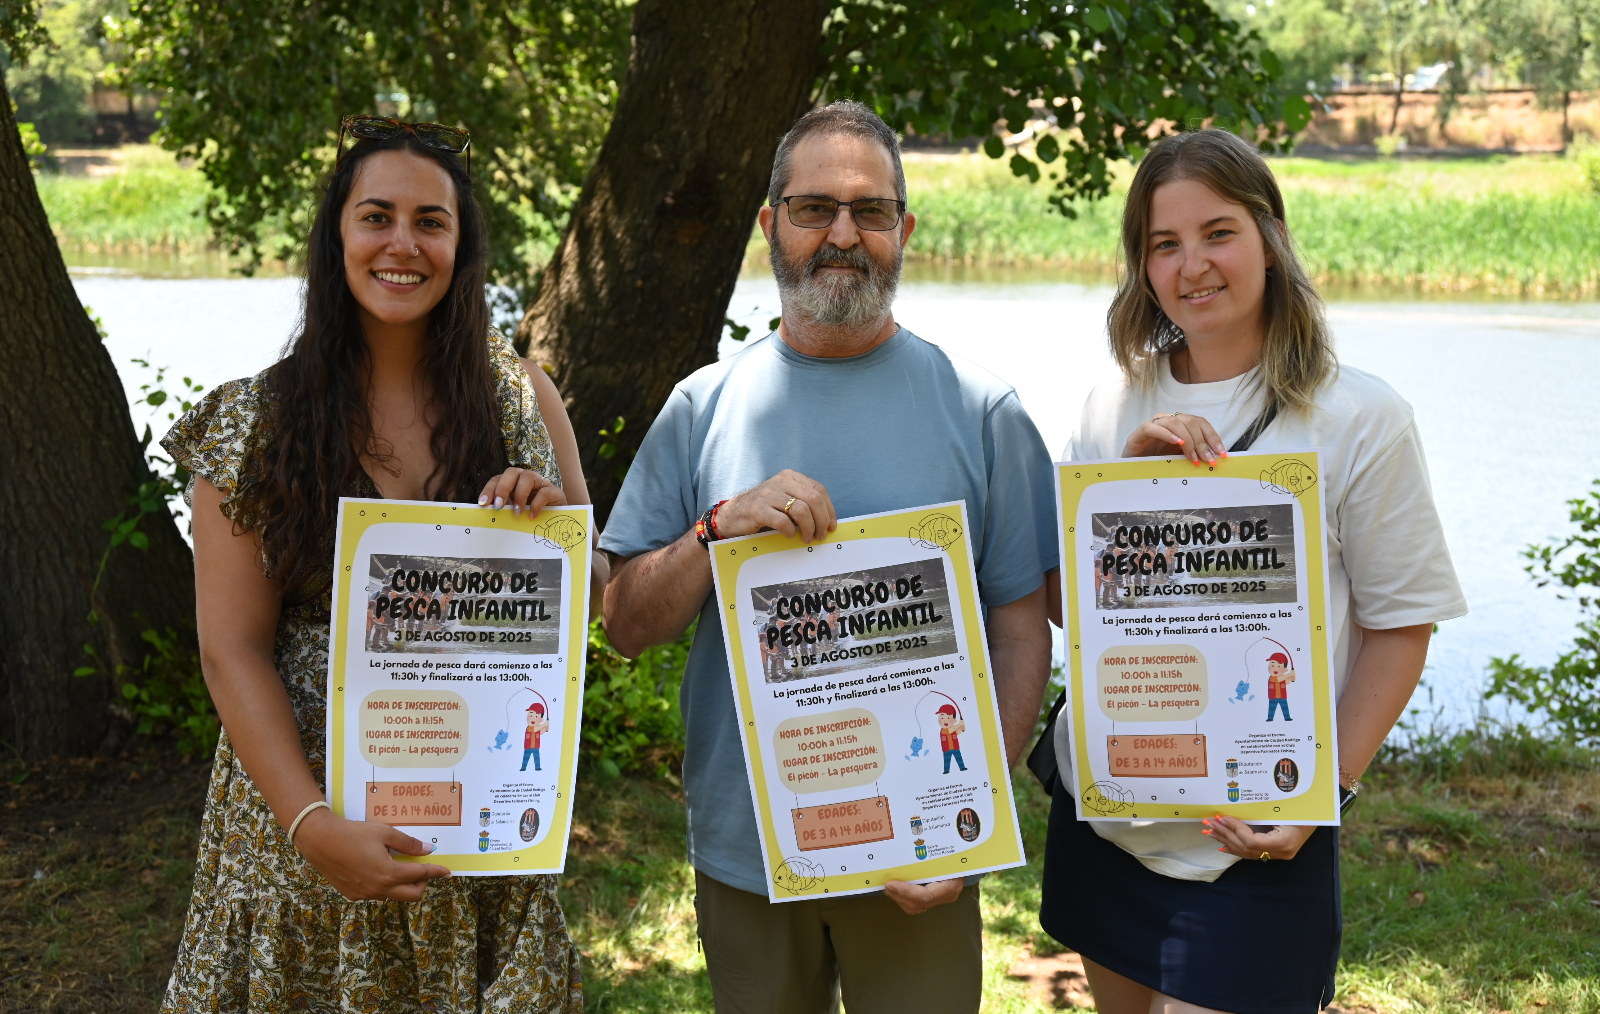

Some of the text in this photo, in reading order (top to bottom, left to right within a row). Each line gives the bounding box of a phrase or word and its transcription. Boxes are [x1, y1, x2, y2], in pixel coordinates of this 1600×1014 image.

[1115, 519, 1268, 548] CONCURSO DE
[1102, 548, 1285, 576] PESCA INFANTIL
[392, 569, 538, 594] CONCURSO DE
[1124, 581, 1266, 596] 3 DE AGOSTO DE 2025
[777, 575, 923, 620] CONCURSO DE
[376, 597, 551, 621] PESCA INFANTIL
[767, 602, 943, 649] PESCA INFANTIL
[1115, 616, 1152, 626] jornada
[1169, 616, 1195, 624] pesca
[1198, 613, 1220, 621] dará
[1223, 612, 1267, 620] comienzo
[394, 631, 532, 642] 3 DE AGOSTO DE 2025
[1125, 628, 1153, 636] 11:30h
[1163, 626, 1208, 635] finalizará
[1220, 625, 1232, 633] las
[1235, 623, 1270, 633] 13:00h.
[791, 636, 928, 668] 3 DE AGOSTO DE 2025
[382, 660, 419, 670] jornada
[422, 660, 433, 668] de
[464, 660, 485, 669] dará
[488, 661, 530, 669] comienzo
[1104, 654, 1198, 666] HORA DE INSCRIPCIÓN:
[391, 672, 418, 681] 11:30h
[421, 674, 427, 683] y
[429, 673, 473, 681] finalizará
[484, 673, 497, 682] las
[500, 674, 532, 682] 13:00h.
[773, 690, 784, 698] La
[786, 685, 822, 698] jornada
[825, 682, 837, 690] de
[839, 678, 864, 689] pesca
[866, 673, 888, 683] dará
[890, 668, 931, 680] comienzo
[942, 662, 954, 670] las
[1121, 671, 1150, 679] 10:00h
[1161, 670, 1182, 678] 11:15h
[796, 696, 824, 707] 11:30h
[827, 696, 832, 705] y
[834, 688, 878, 702] finalizará
[888, 684, 901, 692] las
[903, 678, 936, 689] 13:00h.
[1132, 685, 1142, 693] DE
[1145, 683, 1201, 693] INSCRIPCIÓN:
[367, 700, 461, 710] HORA DE INSCRIPCIÓN:
[1107, 700, 1115, 708] El
[1118, 699, 1139, 710] picón
[1149, 699, 1158, 708] La
[1161, 700, 1199, 709] pesquera
[407, 729, 462, 739] INSCRIPCIÓN:
[780, 717, 871, 739] HORA DE INSCRIPCIÓN:
[798, 740, 827, 751] 10:00h
[837, 735, 857, 746] 11:15h
[1134, 738, 1178, 749] EDADES:
[379, 745, 400, 756] picón
[409, 745, 418, 753] La
[421, 746, 459, 756] pesquera
[810, 755, 820, 764] DE
[823, 746, 878, 762] INSCRIPCIÓN:
[1116, 755, 1198, 768] DE 3 A 14 AÑOS
[788, 773, 796, 781] El
[798, 769, 819, 782] picón
[828, 768, 838, 776] La
[840, 762, 878, 775] pesquera
[392, 785, 433, 796] EDADES:
[374, 803, 452, 816] DE 3 A 14 AÑOS
[818, 804, 861, 820] EDADES:
[803, 820, 883, 841] DE 3 A 14 AÑOS
